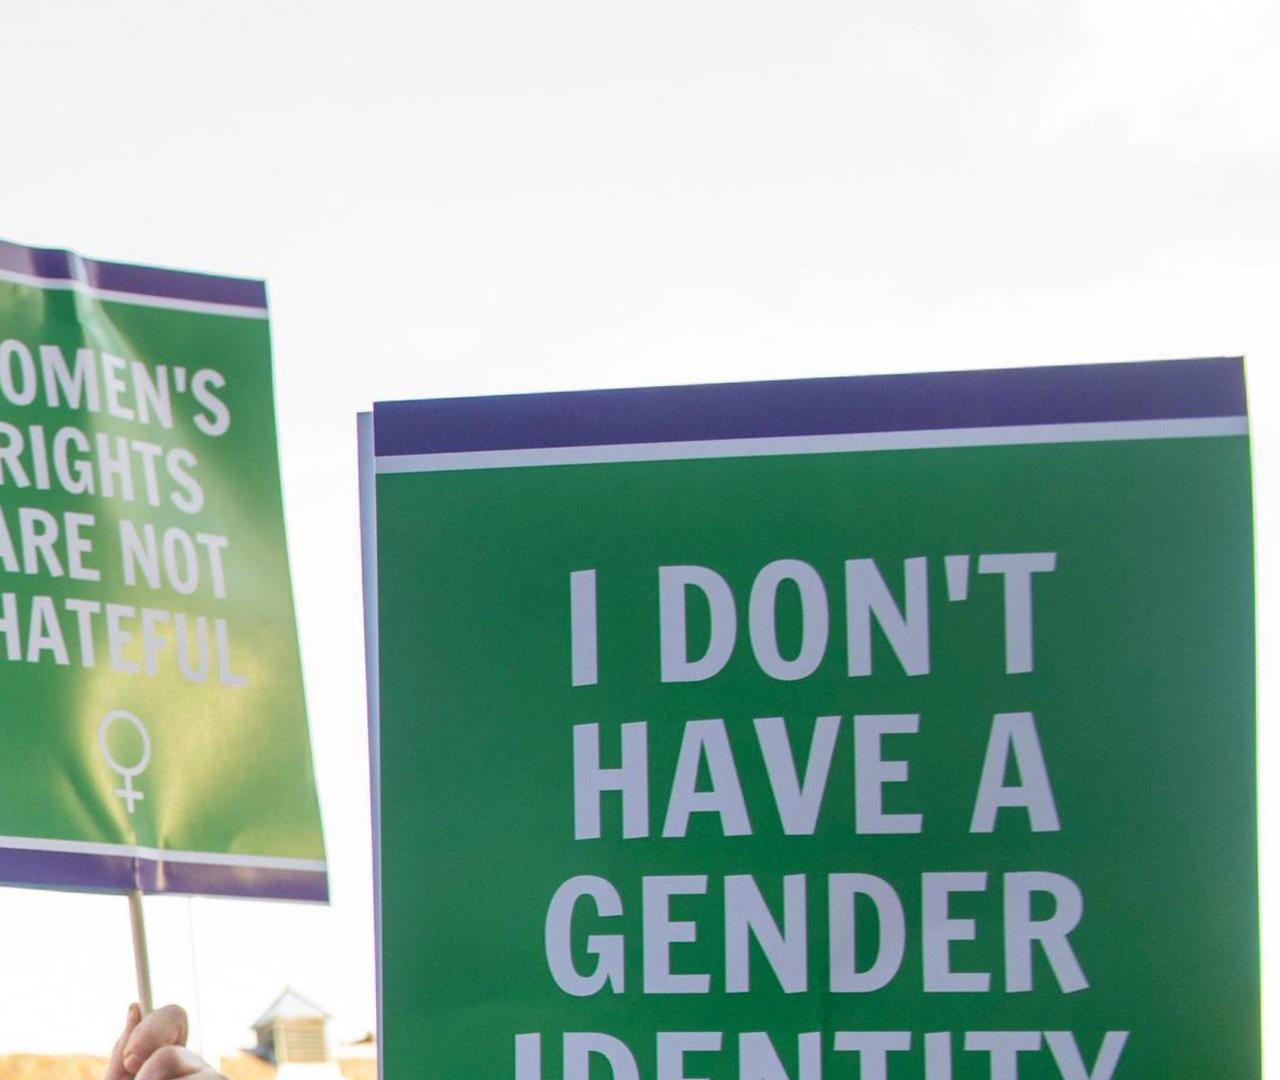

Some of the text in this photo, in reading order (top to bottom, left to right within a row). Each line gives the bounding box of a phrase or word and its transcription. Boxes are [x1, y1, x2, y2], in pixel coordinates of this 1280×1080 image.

[121, 519, 229, 600] NOT
[570, 552, 1057, 686] I DON'T
[573, 712, 1061, 840] HAVE A
[545, 871, 1089, 996] GENDER
